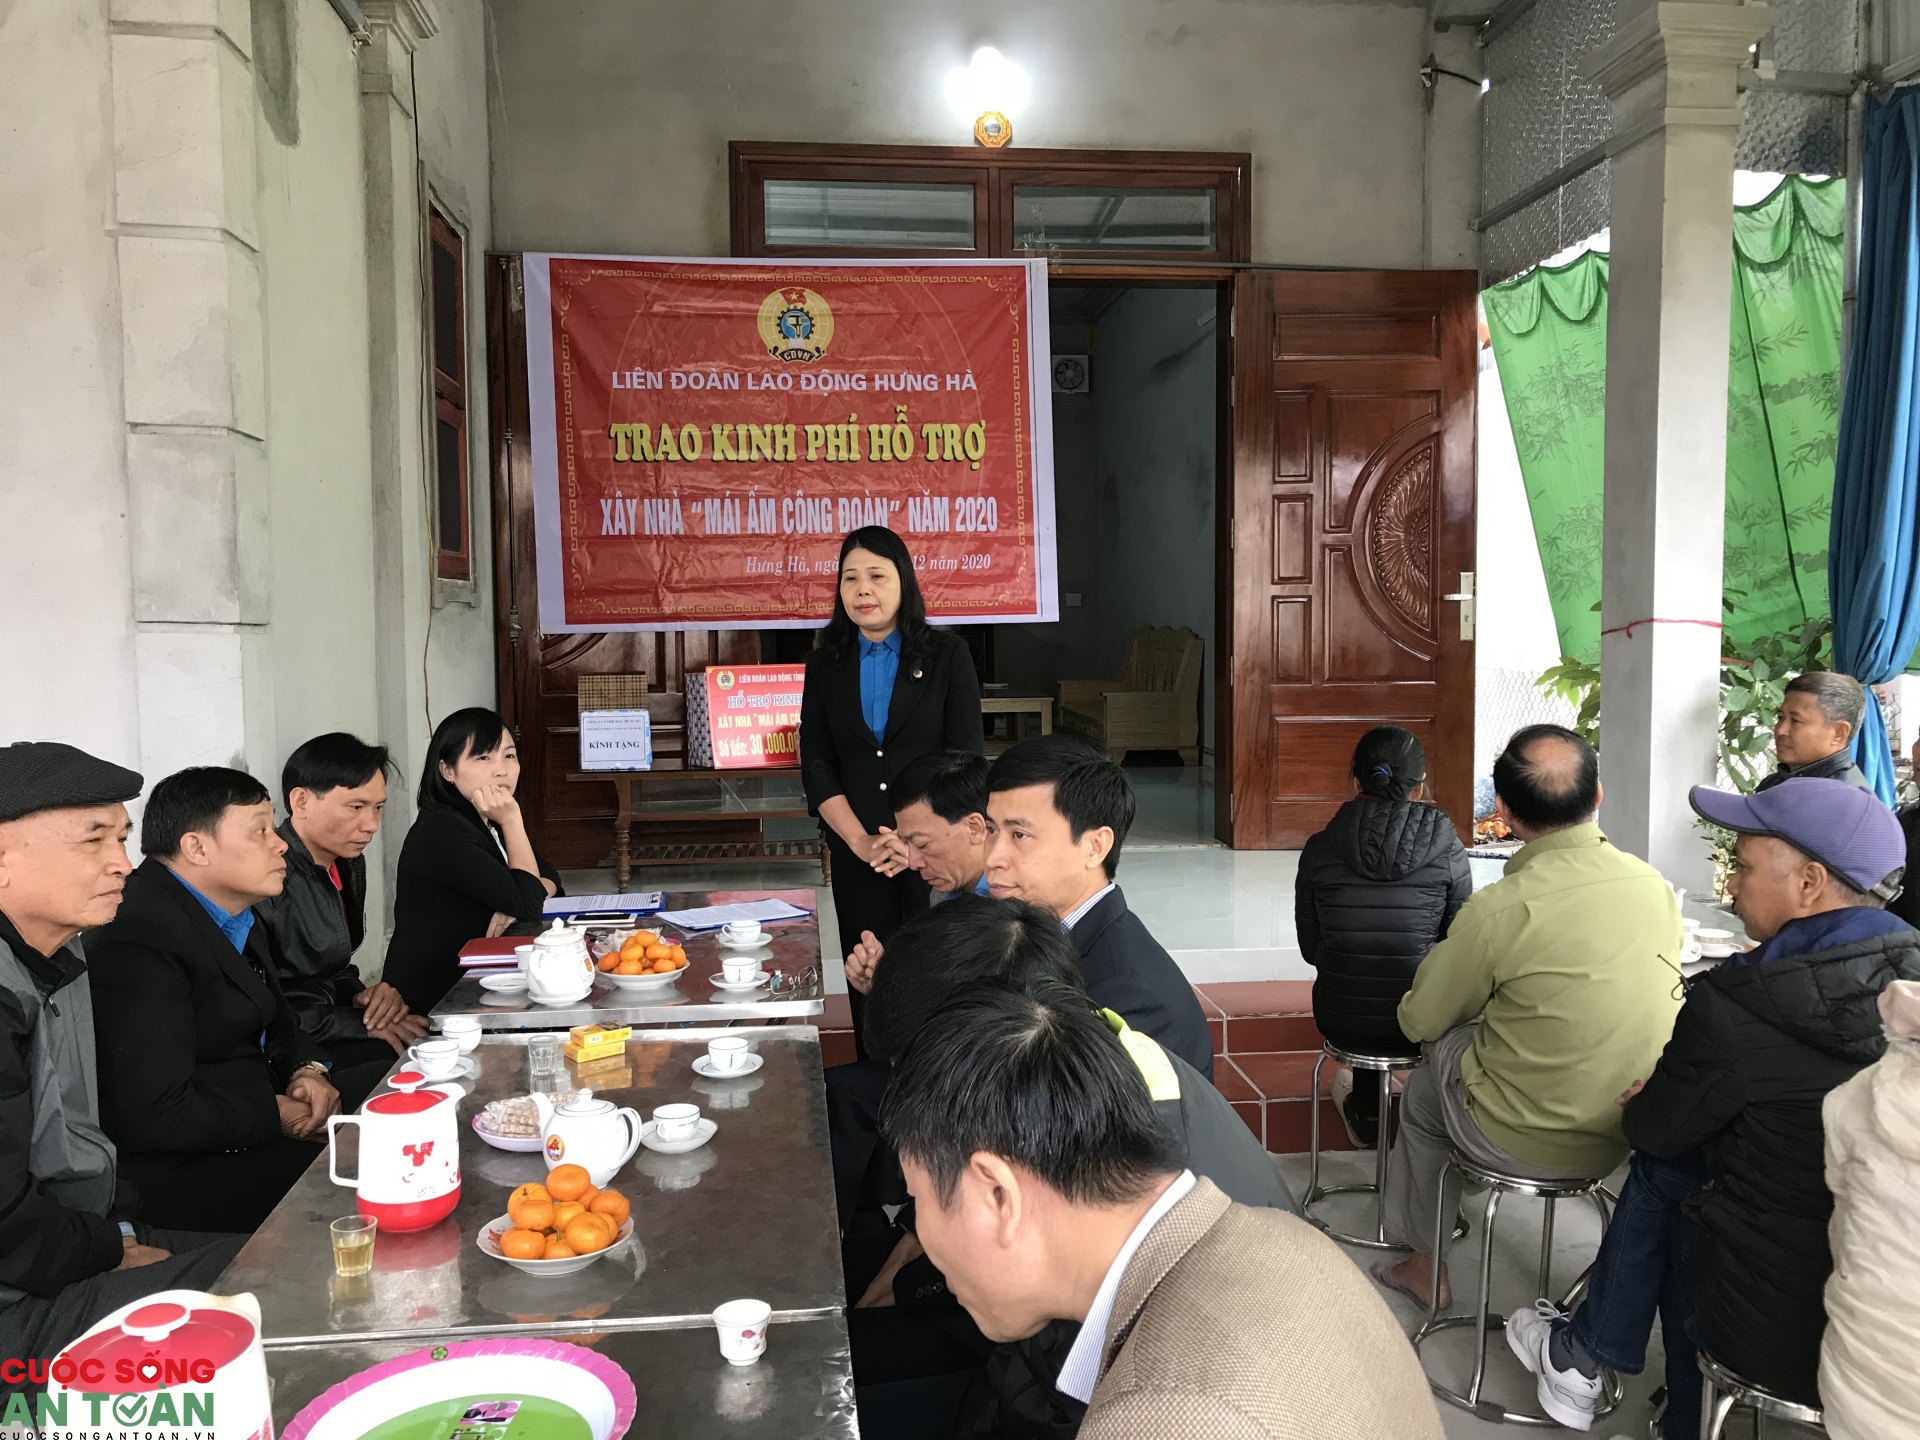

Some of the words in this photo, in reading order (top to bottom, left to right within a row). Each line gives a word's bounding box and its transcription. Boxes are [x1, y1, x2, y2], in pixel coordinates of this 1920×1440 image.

[612, 367, 663, 390] LIÊN
[670, 368, 740, 390] ĐOÀN
[747, 372, 793, 391] LAO
[800, 369, 867, 397] ĐỘNG
[874, 372, 939, 392] HƯNG
[946, 369, 978, 391] HÀ
[609, 422, 703, 462] TRAO
[710, 423, 797, 462] KINH
[803, 412, 861, 462] PHÍ
[867, 404, 914, 462] HỖ
[921, 419, 987, 471] TRỢ
[600, 490, 638, 536] XÂY
[643, 489, 685, 535] NHÀ
[747, 484, 777, 534] ẤM
[782, 489, 833, 534] CÔNG
[908, 489, 950, 533] NĂM
[955, 496, 998, 532] 2020
[745, 556, 784, 576] Hưng
[787, 555, 810, 574] Hà,
[814, 556, 840, 576] ngà
[929, 554, 959, 570] năm
[961, 553, 991, 569] 2020
[739, 674, 751, 684] LIÊN
[767, 674, 777, 683] LAO
[747, 693, 771, 709] TRỢ
[773, 693, 803, 706] KINH
[717, 714, 733, 729] XÂY
[735, 713, 752, 728] NHÀ
[789, 711, 801, 725] CÔ
[589, 740, 613, 749] KÍNH
[615, 741, 640, 750] TẶNG
[718, 737, 730, 758] Số
